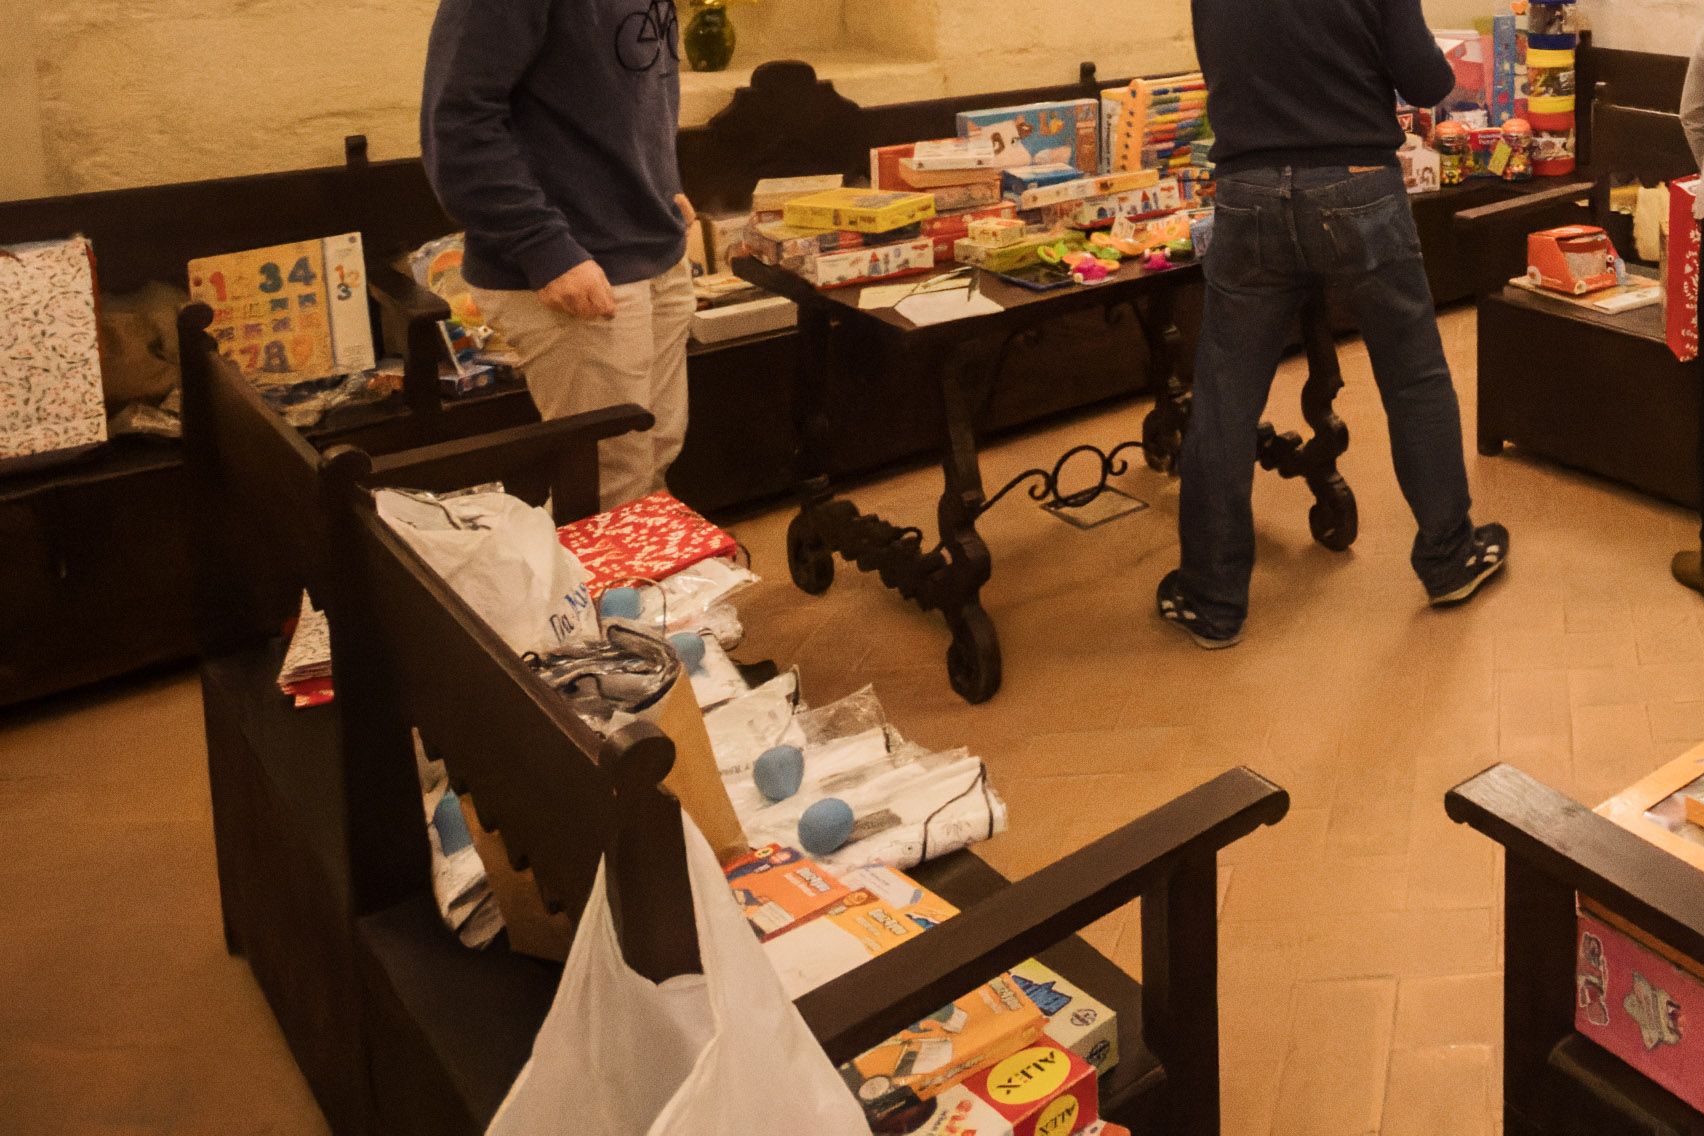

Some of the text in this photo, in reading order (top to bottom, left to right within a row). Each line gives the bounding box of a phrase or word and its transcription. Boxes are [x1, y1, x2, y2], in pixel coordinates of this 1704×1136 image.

[258, 262, 284, 293] 3
[288, 256, 317, 285] 4
[996, 1050, 1056, 1095] ALEX
[1038, 1100, 1077, 1135] ALEX
